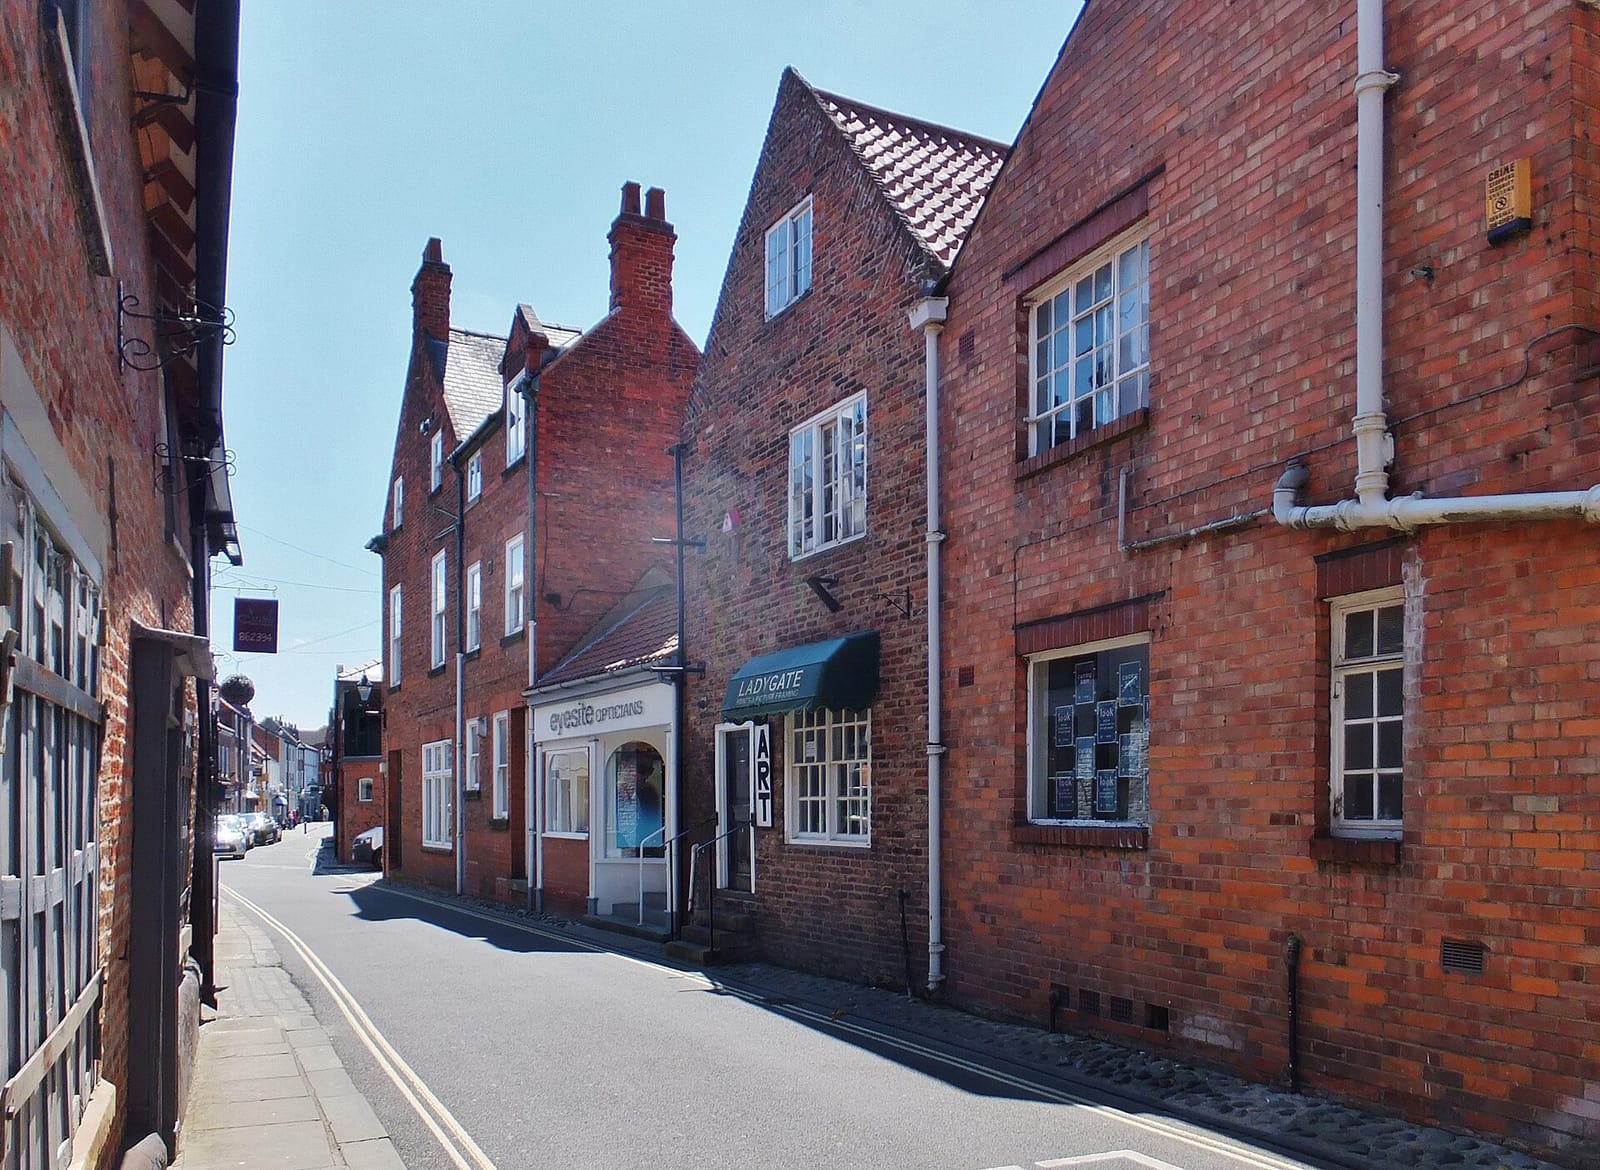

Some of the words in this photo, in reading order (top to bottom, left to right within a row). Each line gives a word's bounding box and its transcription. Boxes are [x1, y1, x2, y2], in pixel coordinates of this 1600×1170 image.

[1488, 162, 1515, 181] CRIME
[738, 670, 804, 697] LADYGATE
[550, 702, 594, 735] eyesite
[595, 700, 643, 722] OPTICIANS
[1058, 711, 1071, 721] look
[1100, 707, 1114, 718] look
[757, 729, 770, 822] ART
[1100, 775, 1114, 786] look
